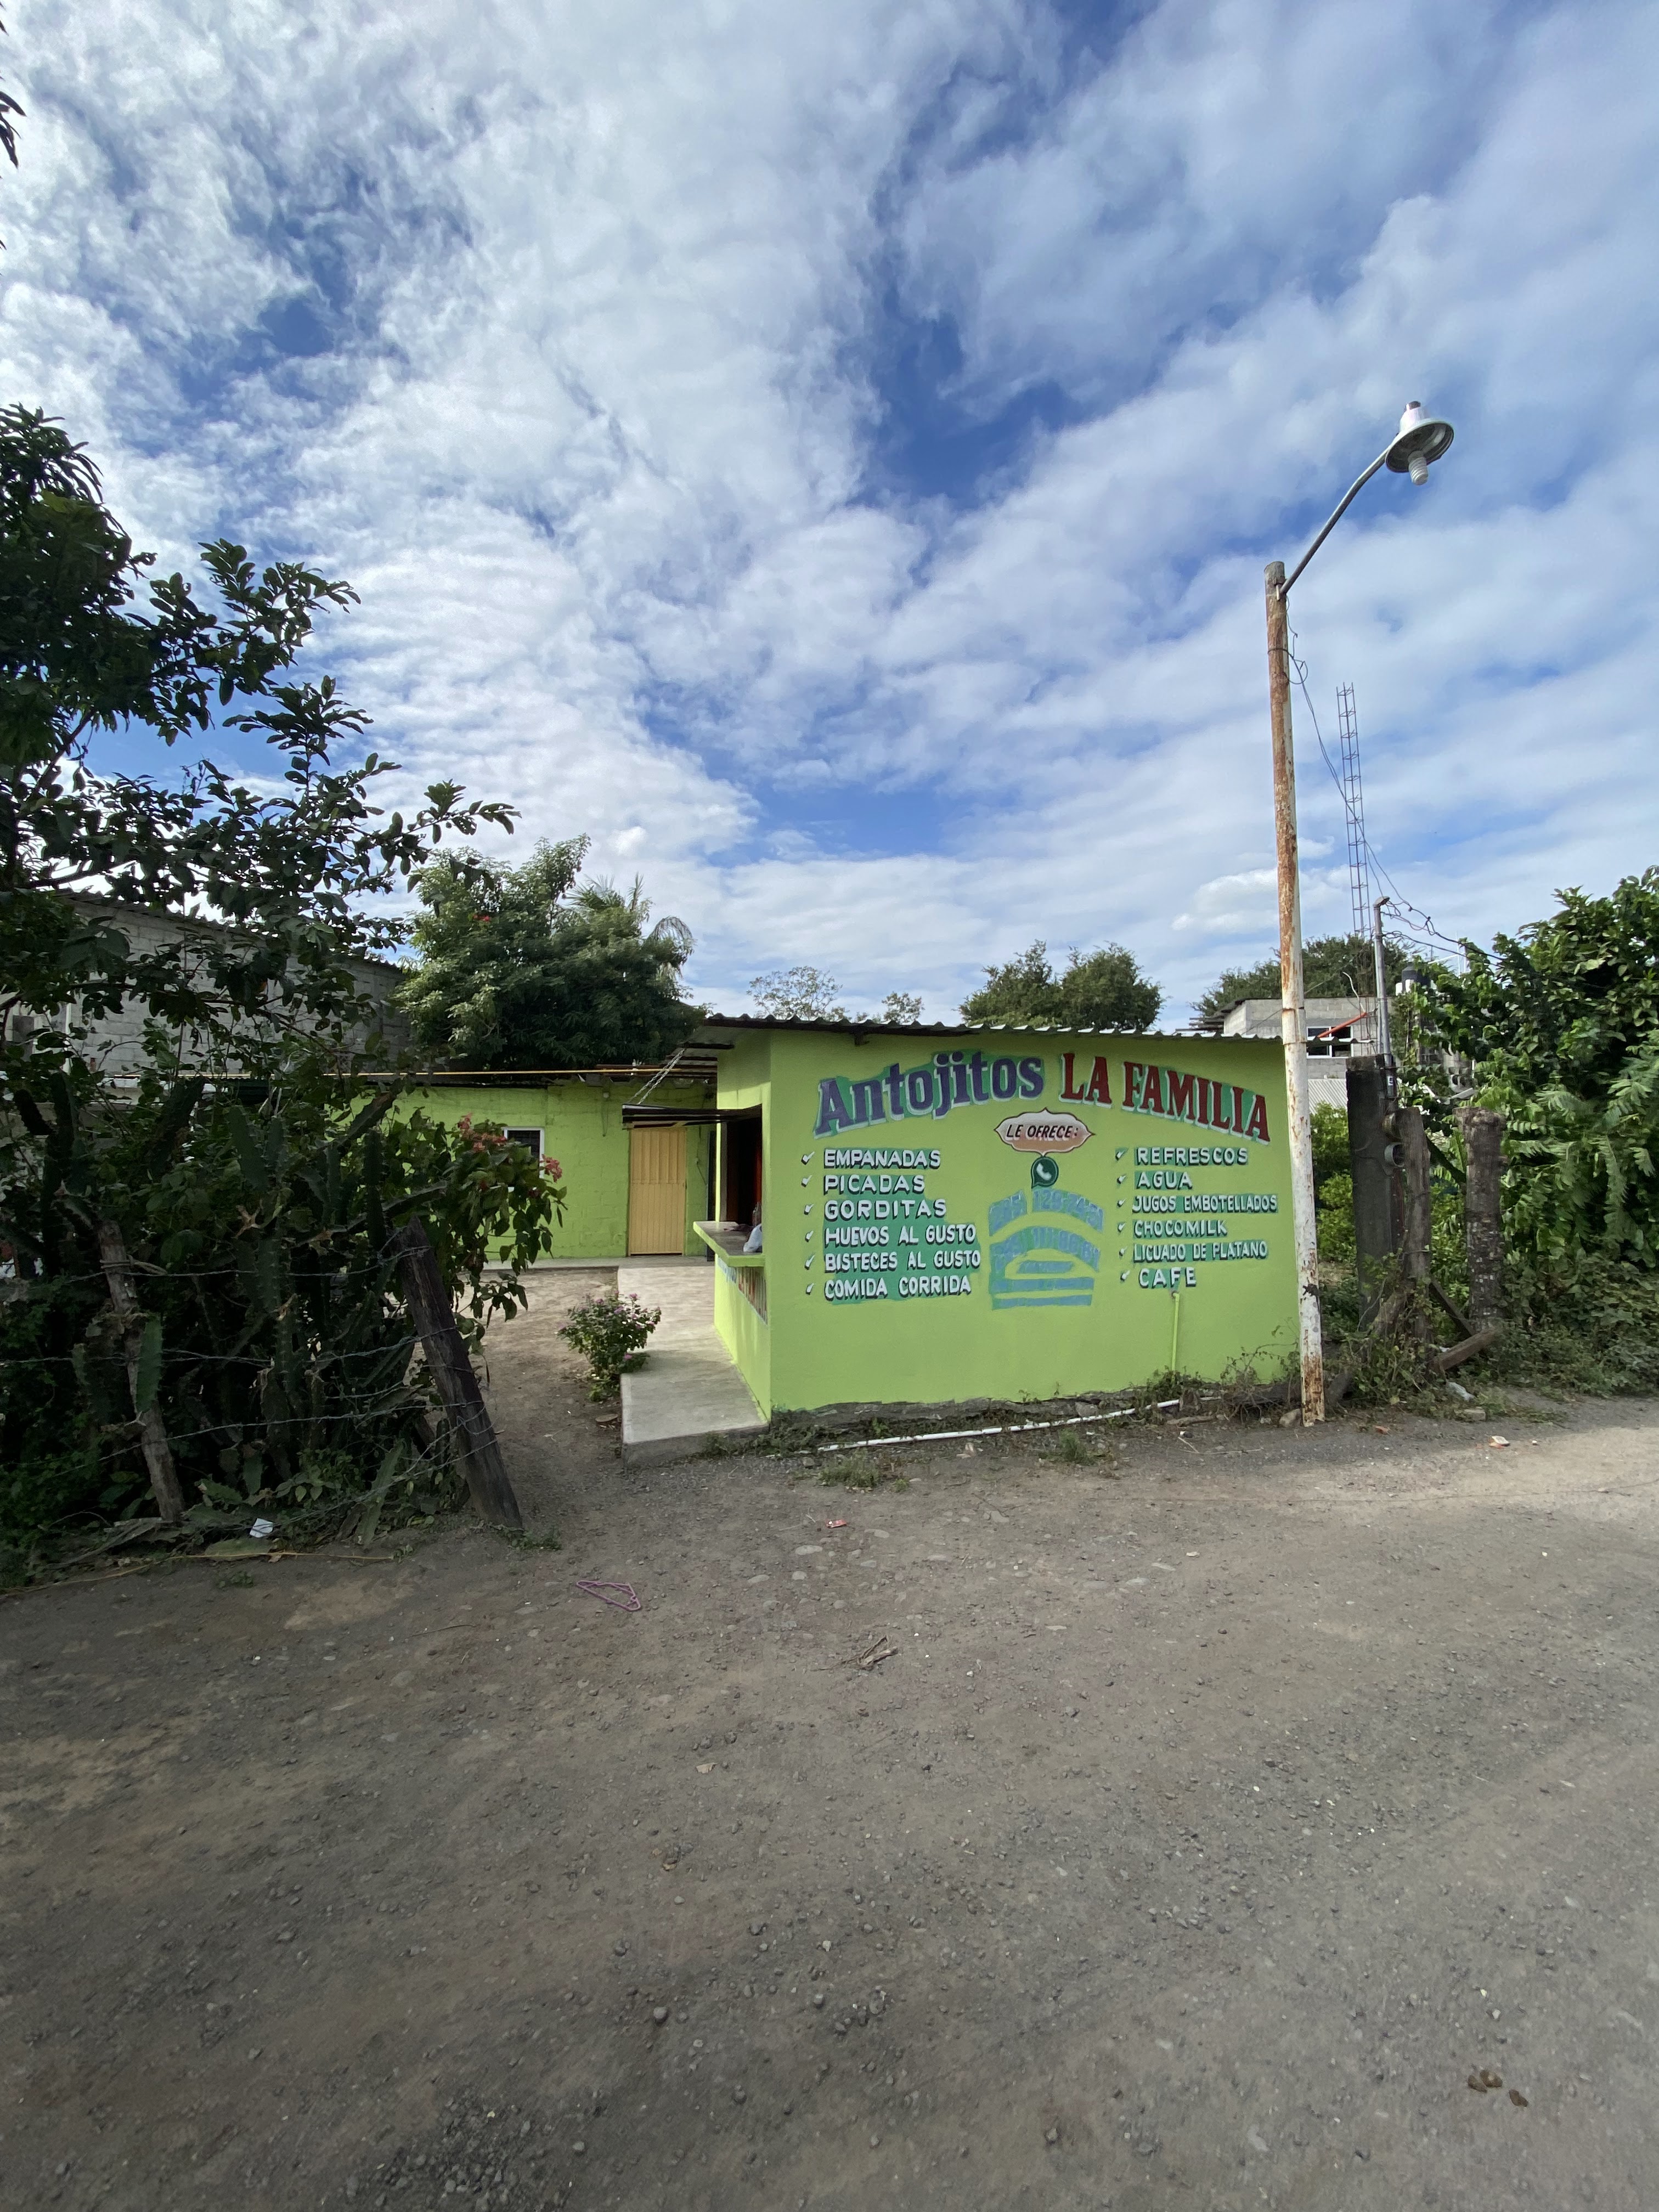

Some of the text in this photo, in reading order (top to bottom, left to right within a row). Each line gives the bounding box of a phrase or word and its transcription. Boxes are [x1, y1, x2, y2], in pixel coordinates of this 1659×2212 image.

[814, 1051, 1271, 1145] Antojitos LA FAMILIA
[1005, 1124, 1024, 1140] LE
[824, 1149, 941, 1169] EMPANADAS
[1136, 1147, 1248, 1165] REFRESCOS
[824, 1175, 925, 1195] PICADAS
[1136, 1171, 1193, 1190] AGUA
[825, 1199, 947, 1221] GORDITAS
[1132, 1195, 1278, 1213] JUGOS EMBOTELLADOS
[825, 1224, 977, 1248] HUEVOS AL GUSTO
[1133, 1220, 1227, 1238] CHOCOMILK
[825, 1250, 981, 1273] BISTECES AL GUSTO
[1133, 1240, 1268, 1263] LICUADO DE PLATANO
[1139, 1267, 1197, 1288] CAFE
[825, 1275, 972, 1301] COMIDA CORRIDA
